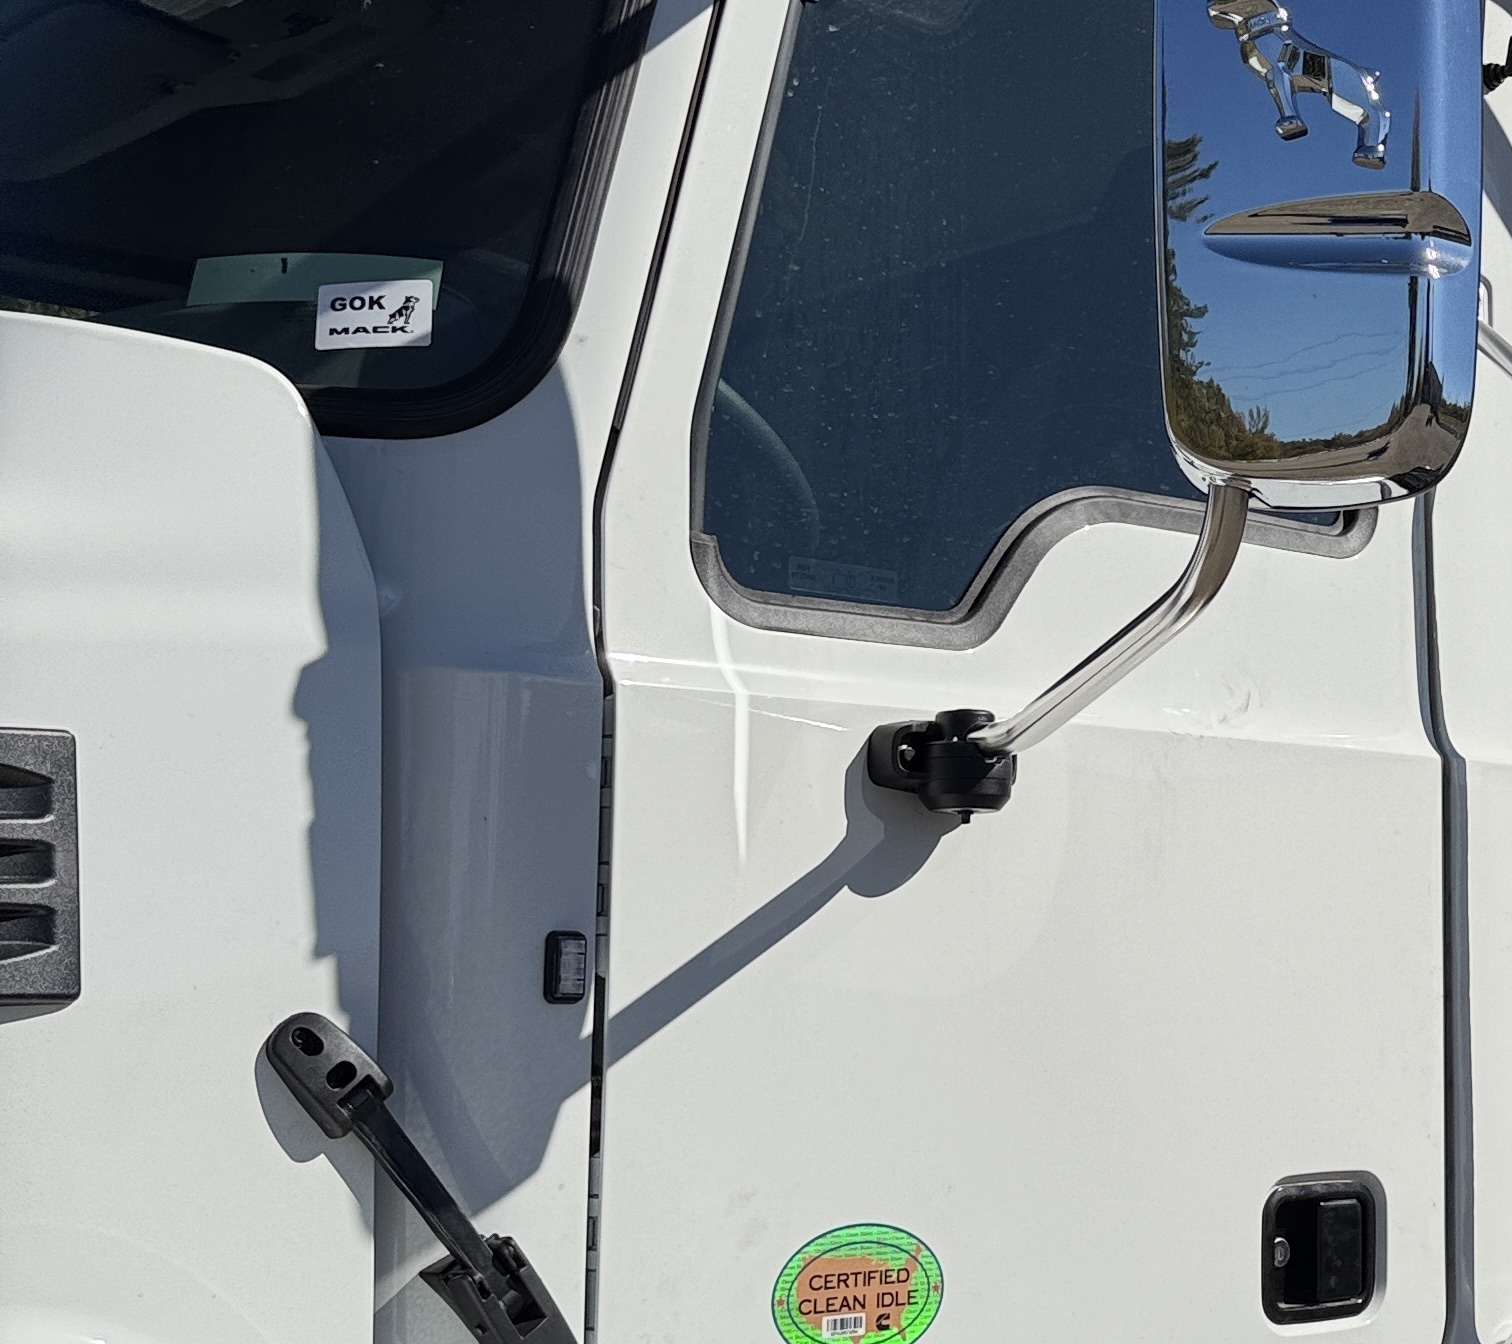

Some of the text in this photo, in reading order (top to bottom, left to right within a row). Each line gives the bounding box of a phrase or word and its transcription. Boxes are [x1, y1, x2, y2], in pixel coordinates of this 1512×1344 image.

[330, 295, 387, 312] GOK
[328, 325, 410, 336] MACK
[809, 1267, 910, 1291] CERTIFIED
[799, 1289, 919, 1316] CLEAN IDLE
